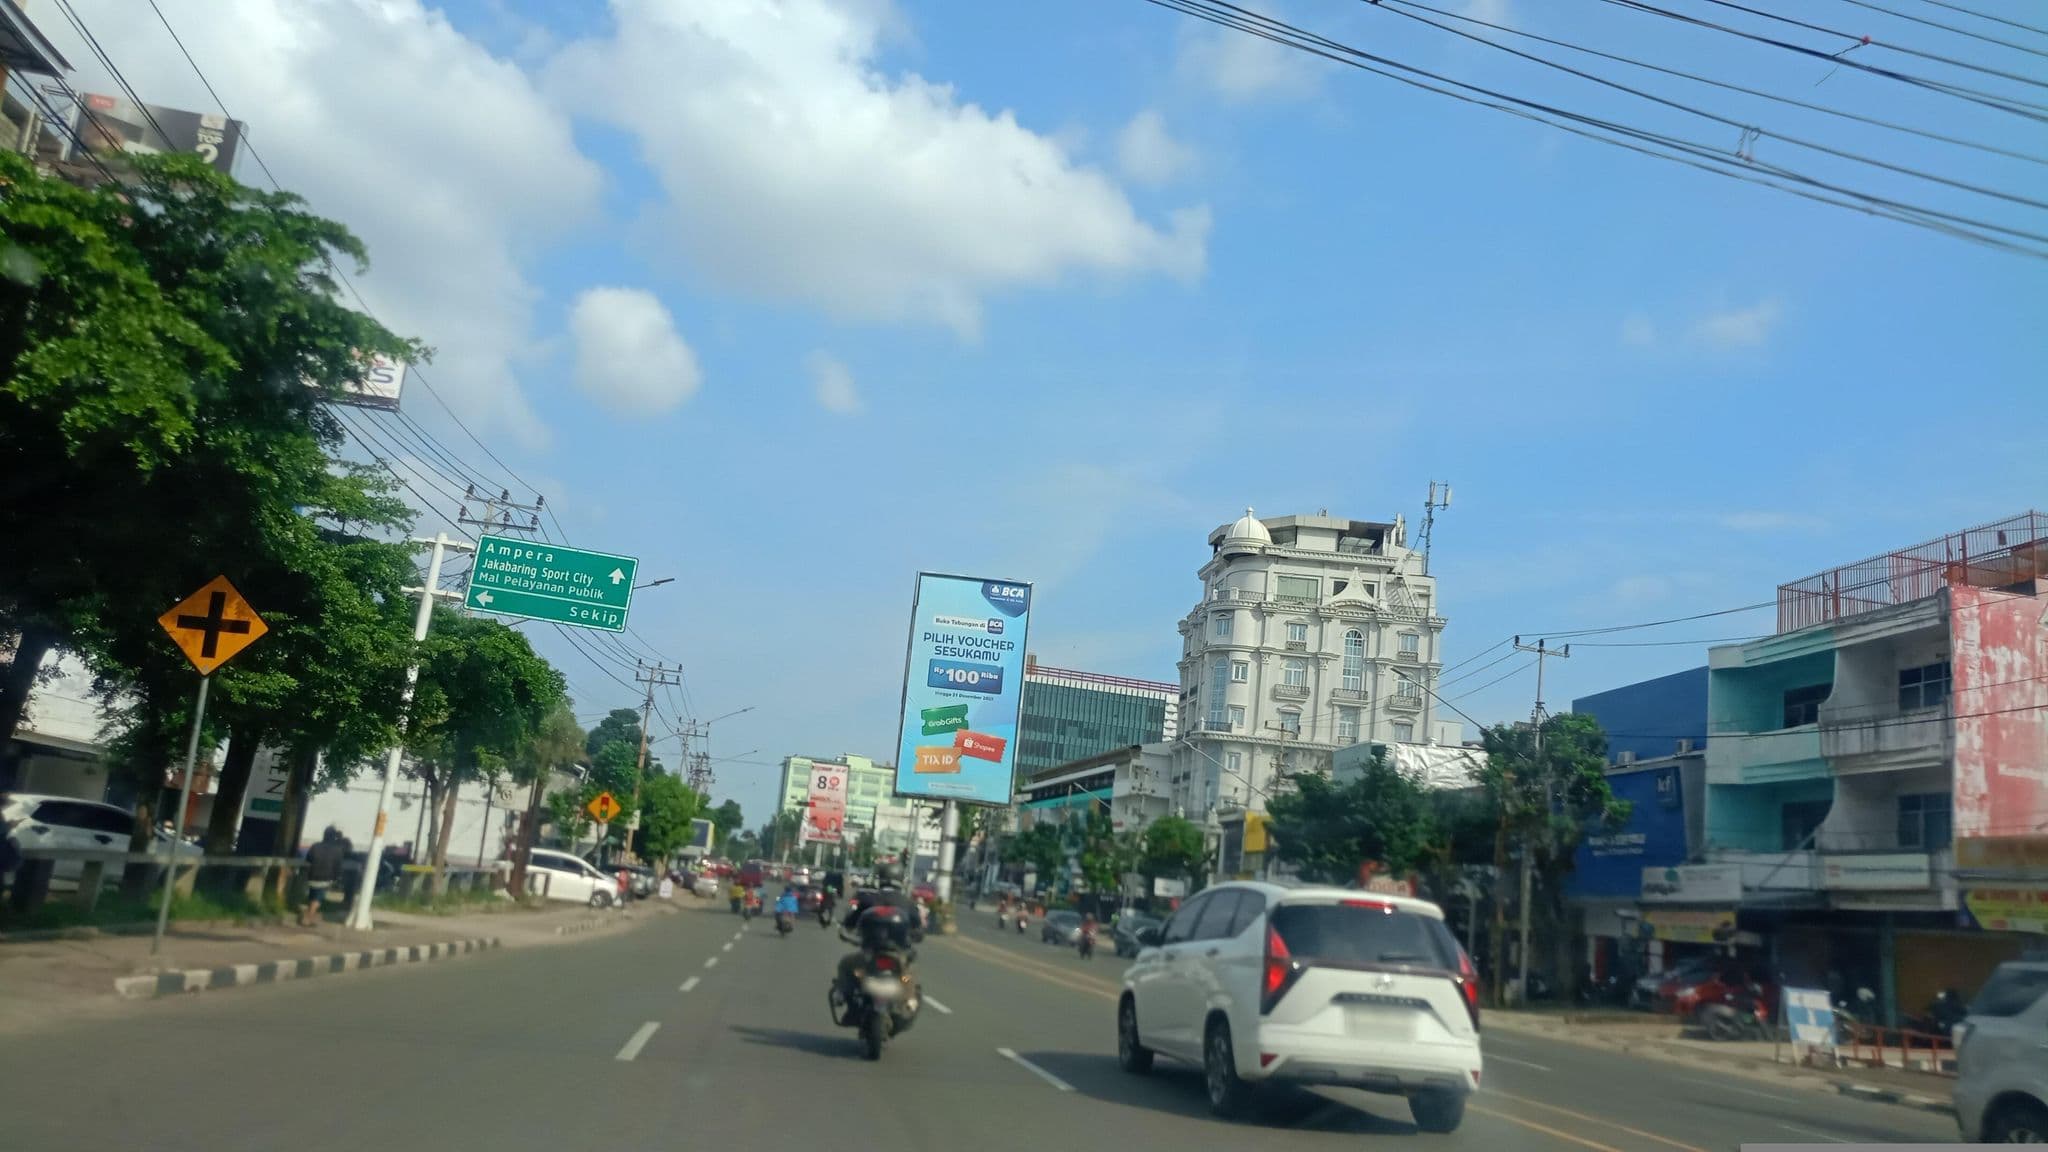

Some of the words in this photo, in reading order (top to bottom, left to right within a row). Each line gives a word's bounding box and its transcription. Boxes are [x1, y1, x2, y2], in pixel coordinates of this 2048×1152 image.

[197, 131, 224, 145] TOP
[485, 543, 554, 563] Ampera
[481, 558, 538, 579] Jakabaring
[542, 567, 570, 582] Sport
[573, 572, 594, 588] City
[478, 571, 499, 584] Mal
[504, 573, 565, 593] Pelayanan
[568, 585, 604, 600] Publik
[1001, 587, 1025, 599] BCA
[569, 606, 617, 625] Sekip
[923, 632, 954, 645] PILIH
[957, 635, 1015, 652] VOUCHER
[934, 645, 1000, 661] SESUKAMU
[934, 666, 945, 675] Rp
[946, 668, 979, 685] 100
[981, 671, 999, 680] Ribu
[973, 741, 996, 753] Shopee
[922, 754, 940, 765] TIX
[942, 754, 954, 765] ID
